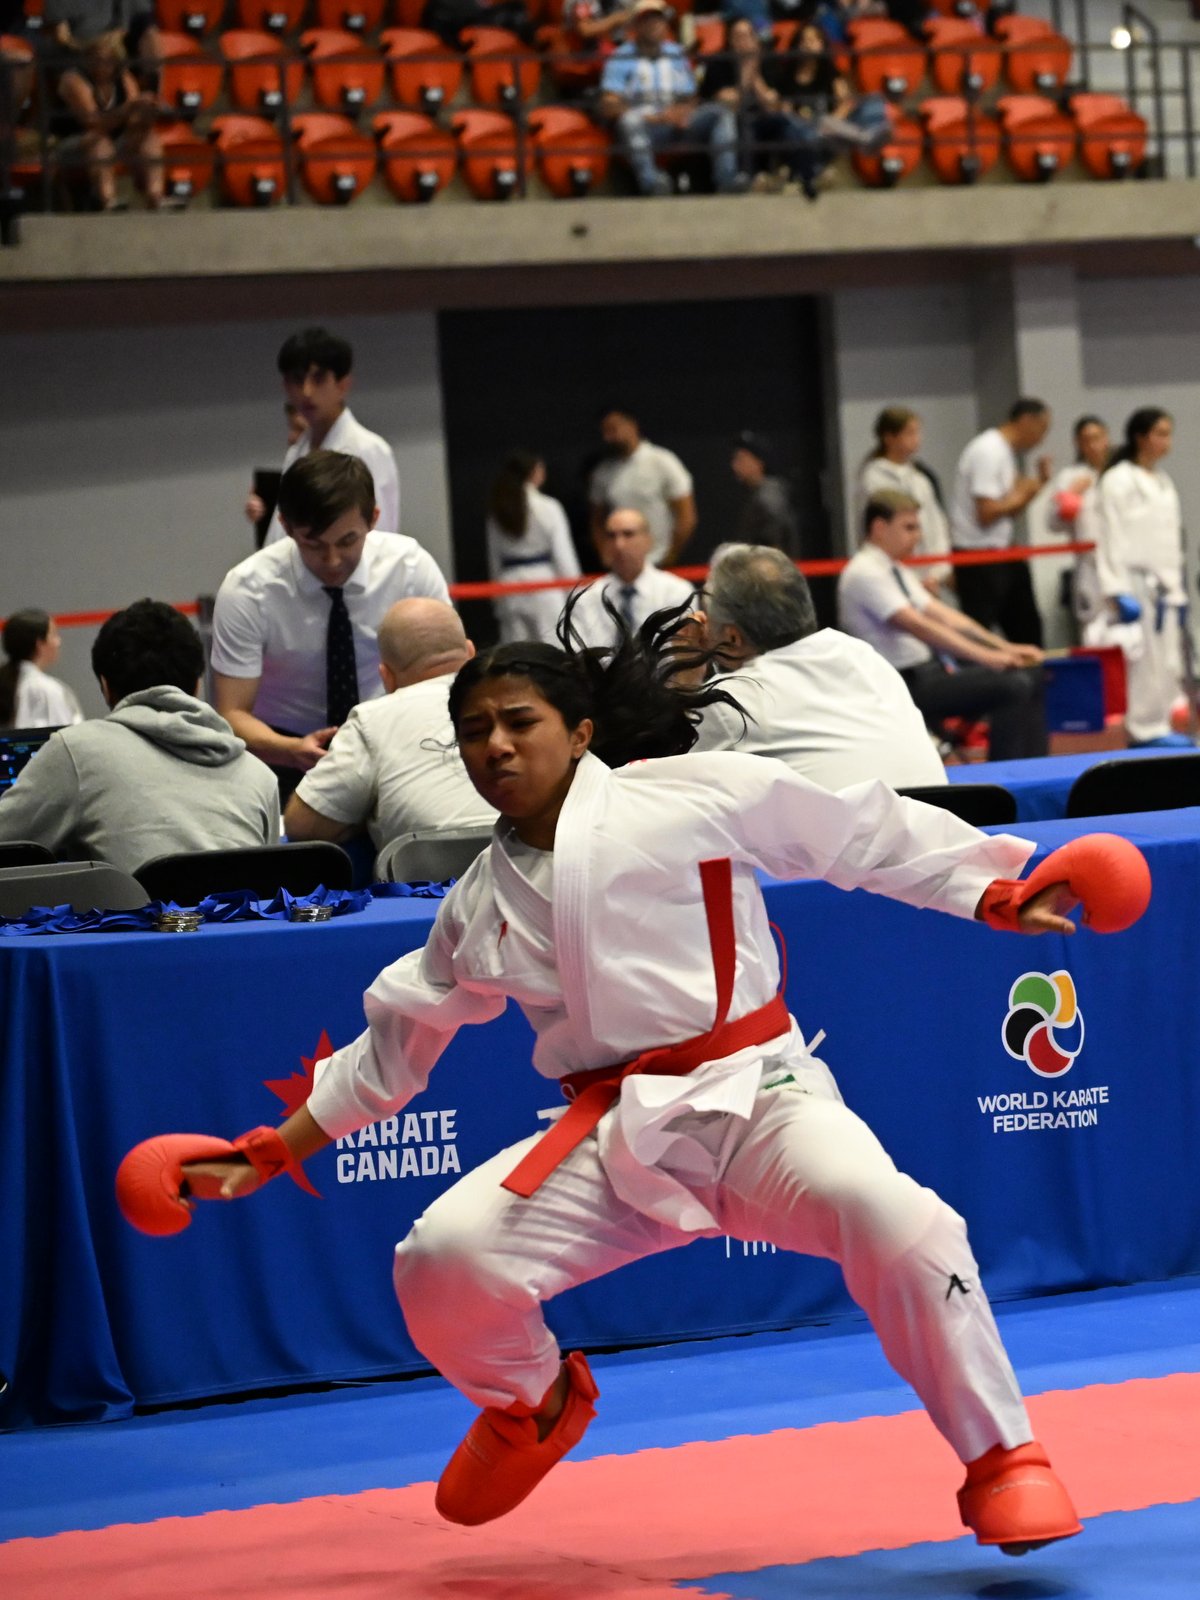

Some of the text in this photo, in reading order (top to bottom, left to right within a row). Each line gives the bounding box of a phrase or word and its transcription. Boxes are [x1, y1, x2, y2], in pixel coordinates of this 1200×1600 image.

[977, 1086, 1109, 1114] WORLD KARATE
[993, 1108, 1098, 1133] FEDERATION
[336, 1144, 461, 1184] CANADA
